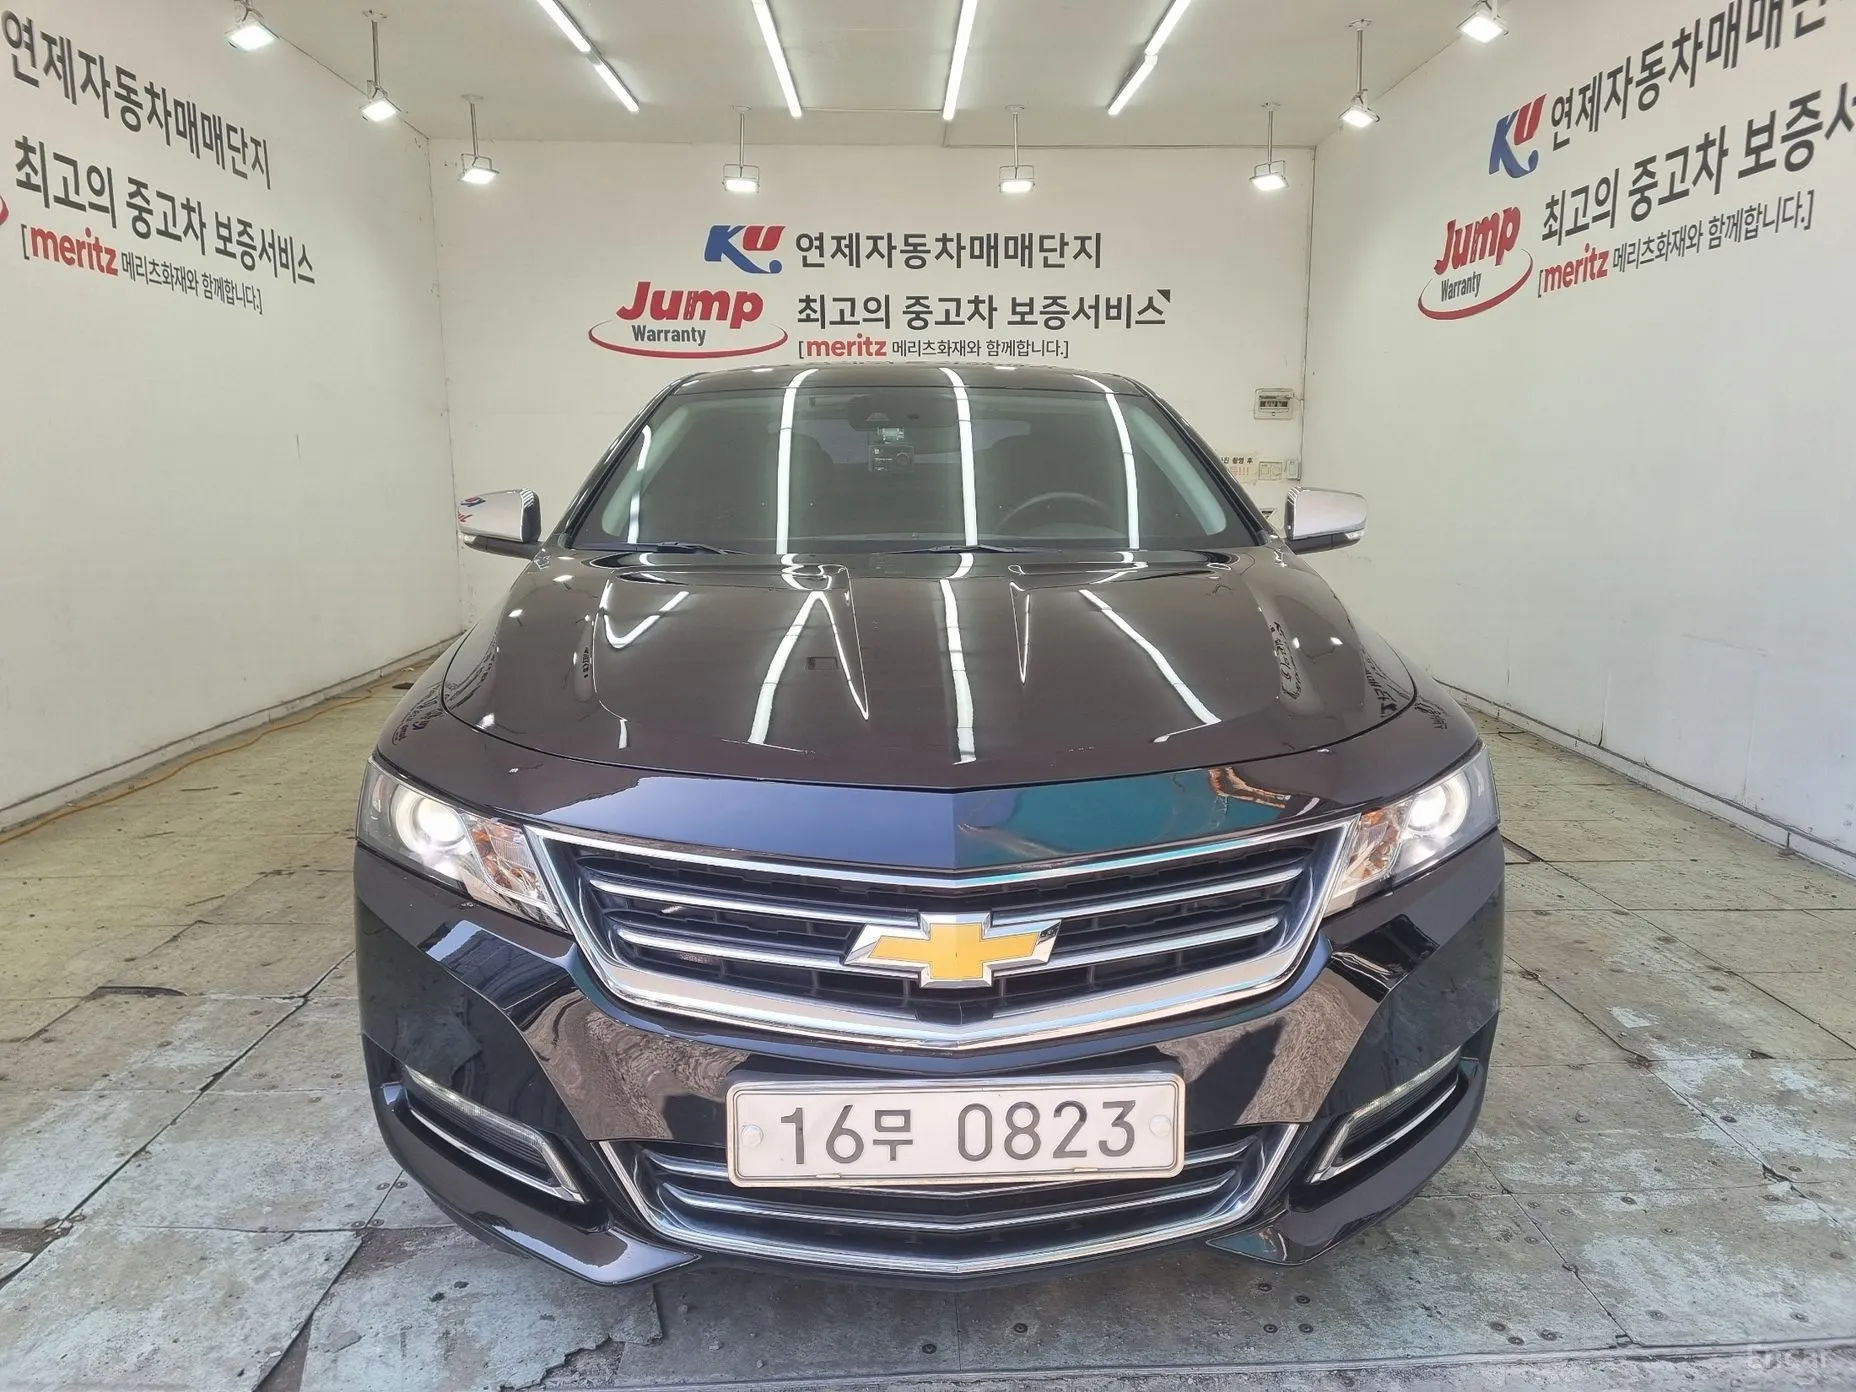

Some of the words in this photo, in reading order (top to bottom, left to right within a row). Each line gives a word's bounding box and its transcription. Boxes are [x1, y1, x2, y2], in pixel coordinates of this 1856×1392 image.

[2, 9, 271, 190] 연제자동차매매단지
[14, 135, 117, 229] 최고의
[126, 177, 207, 256] 중고차
[214, 211, 315, 284] 보증서비스
[1542, 168, 1620, 246] 최고의
[1628, 125, 1729, 222] 중고차
[795, 231, 1101, 269] 연제자동차매매단지
[1434, 207, 1521, 275] Jump
[1612, 220, 1703, 273] 메리츠화재와
[121, 252, 199, 297] 메리츠화재와
[1441, 271, 1482, 302] Warranty
[616, 281, 764, 330] Jump
[798, 294, 891, 330] 최고의
[902, 294, 998, 330] 중고차
[1007, 294, 1166, 330] 보증서비스
[632, 324, 706, 346] Warranty
[892, 340, 981, 357] 메리츠화재와
[781, 1104, 913, 1165] 16무
[957, 1100, 1136, 1161] 0823
